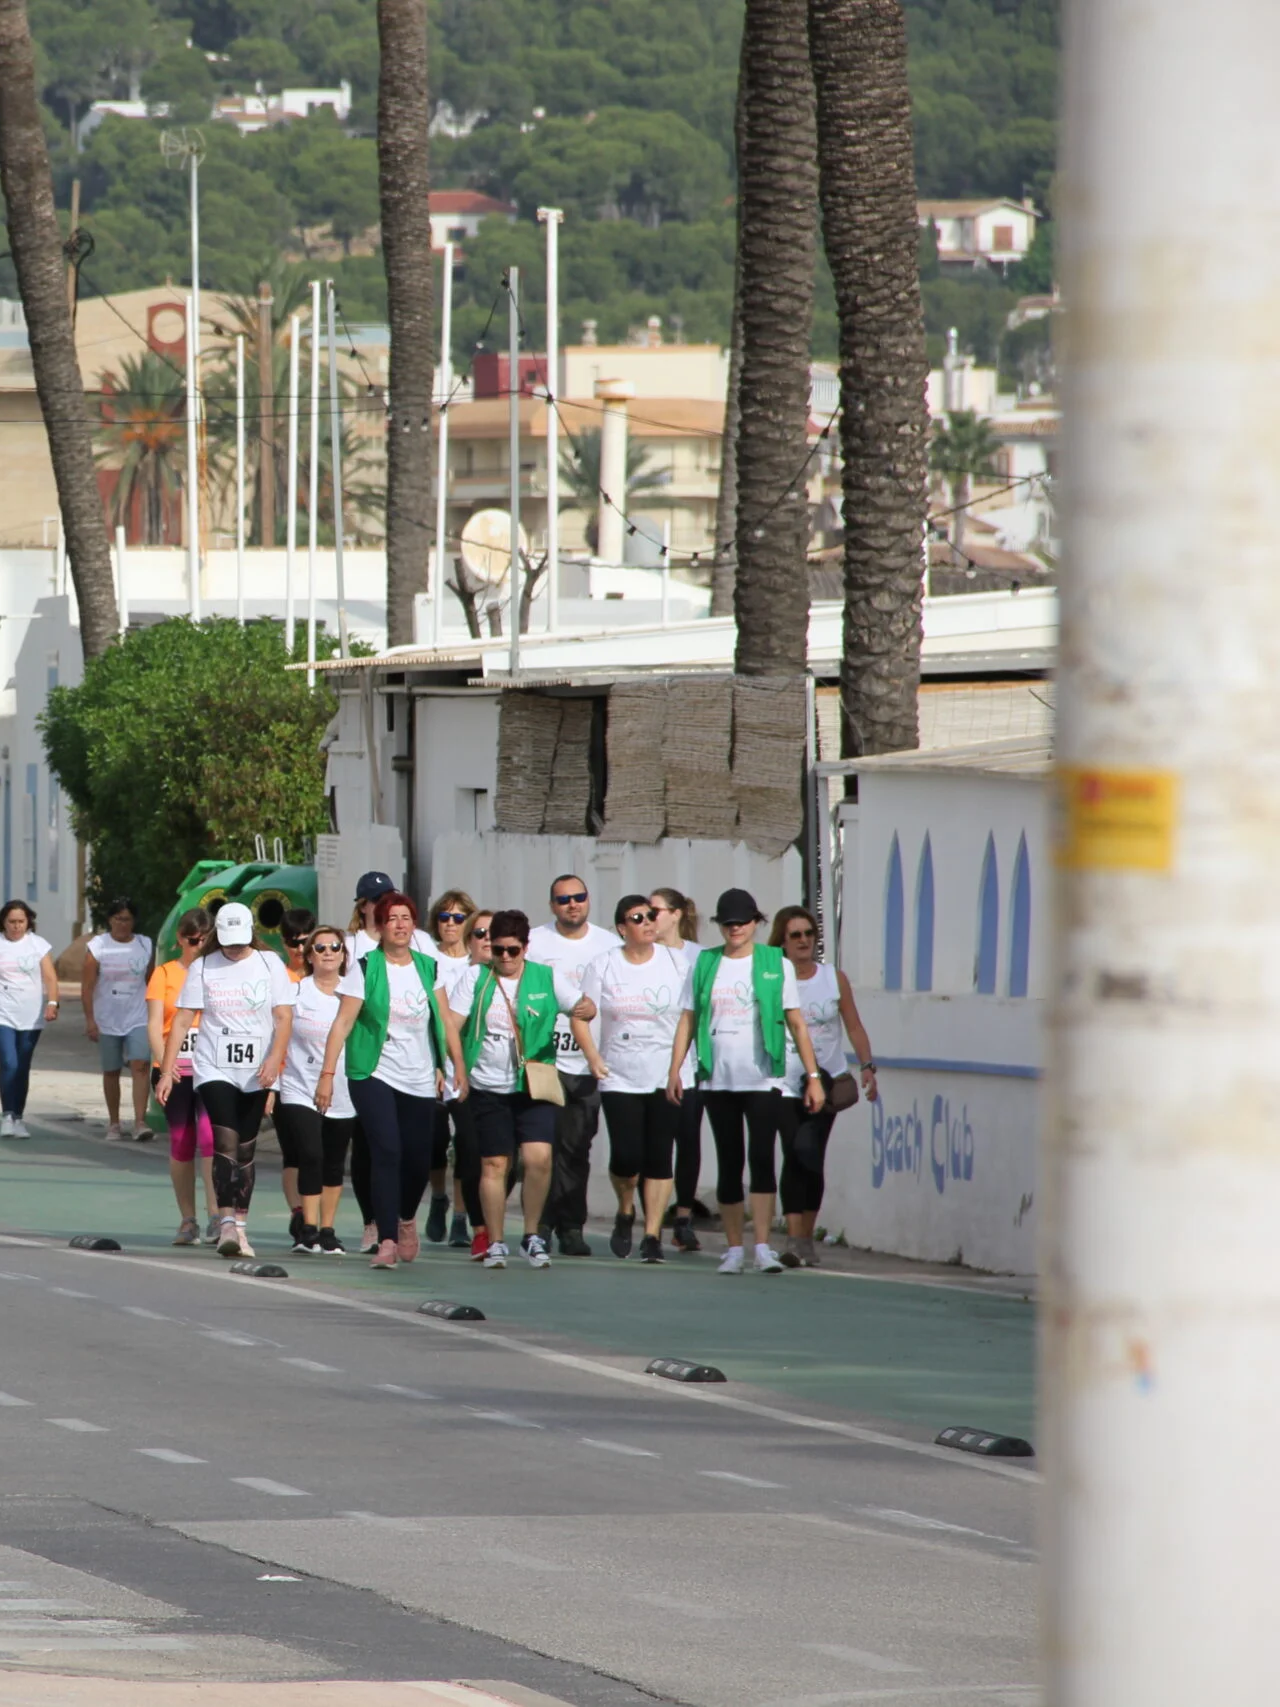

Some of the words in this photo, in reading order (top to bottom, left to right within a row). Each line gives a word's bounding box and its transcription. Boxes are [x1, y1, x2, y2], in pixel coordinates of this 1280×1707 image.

[226, 1043, 255, 1064] 154
[871, 1094, 923, 1189] Beach
[931, 1094, 975, 1195] Club
